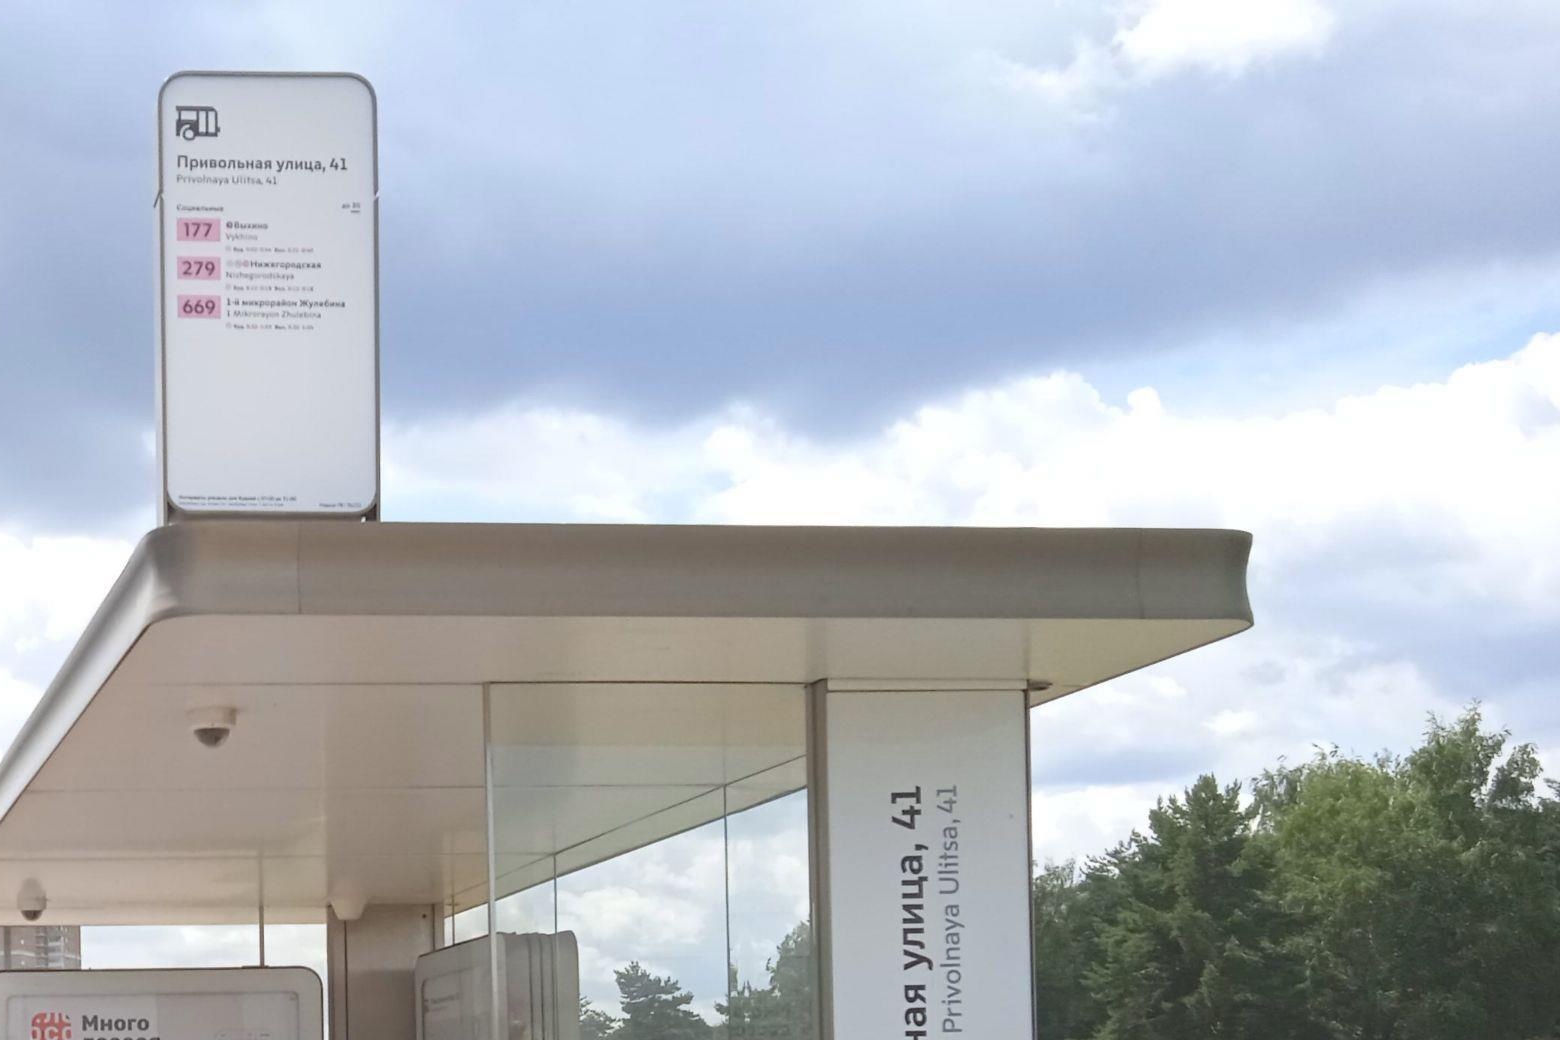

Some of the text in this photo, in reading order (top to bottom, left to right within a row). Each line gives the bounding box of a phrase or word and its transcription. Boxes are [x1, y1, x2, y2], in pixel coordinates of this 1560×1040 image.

[177, 155, 348, 173] Привольная улица, 41
[176, 175, 229, 186] Privolnaya
[266, 176, 278, 186] 41
[184, 222, 213, 238] 177
[183, 261, 216, 276] 279
[250, 261, 322, 270] Нижегородская
[183, 299, 216, 315] 669
[891, 785, 922, 830] 41
[900, 843, 934, 971] улица,
[936, 785, 966, 1034] Privolnaya Ulitsa, 41
[81, 1014, 150, 1032] Много
